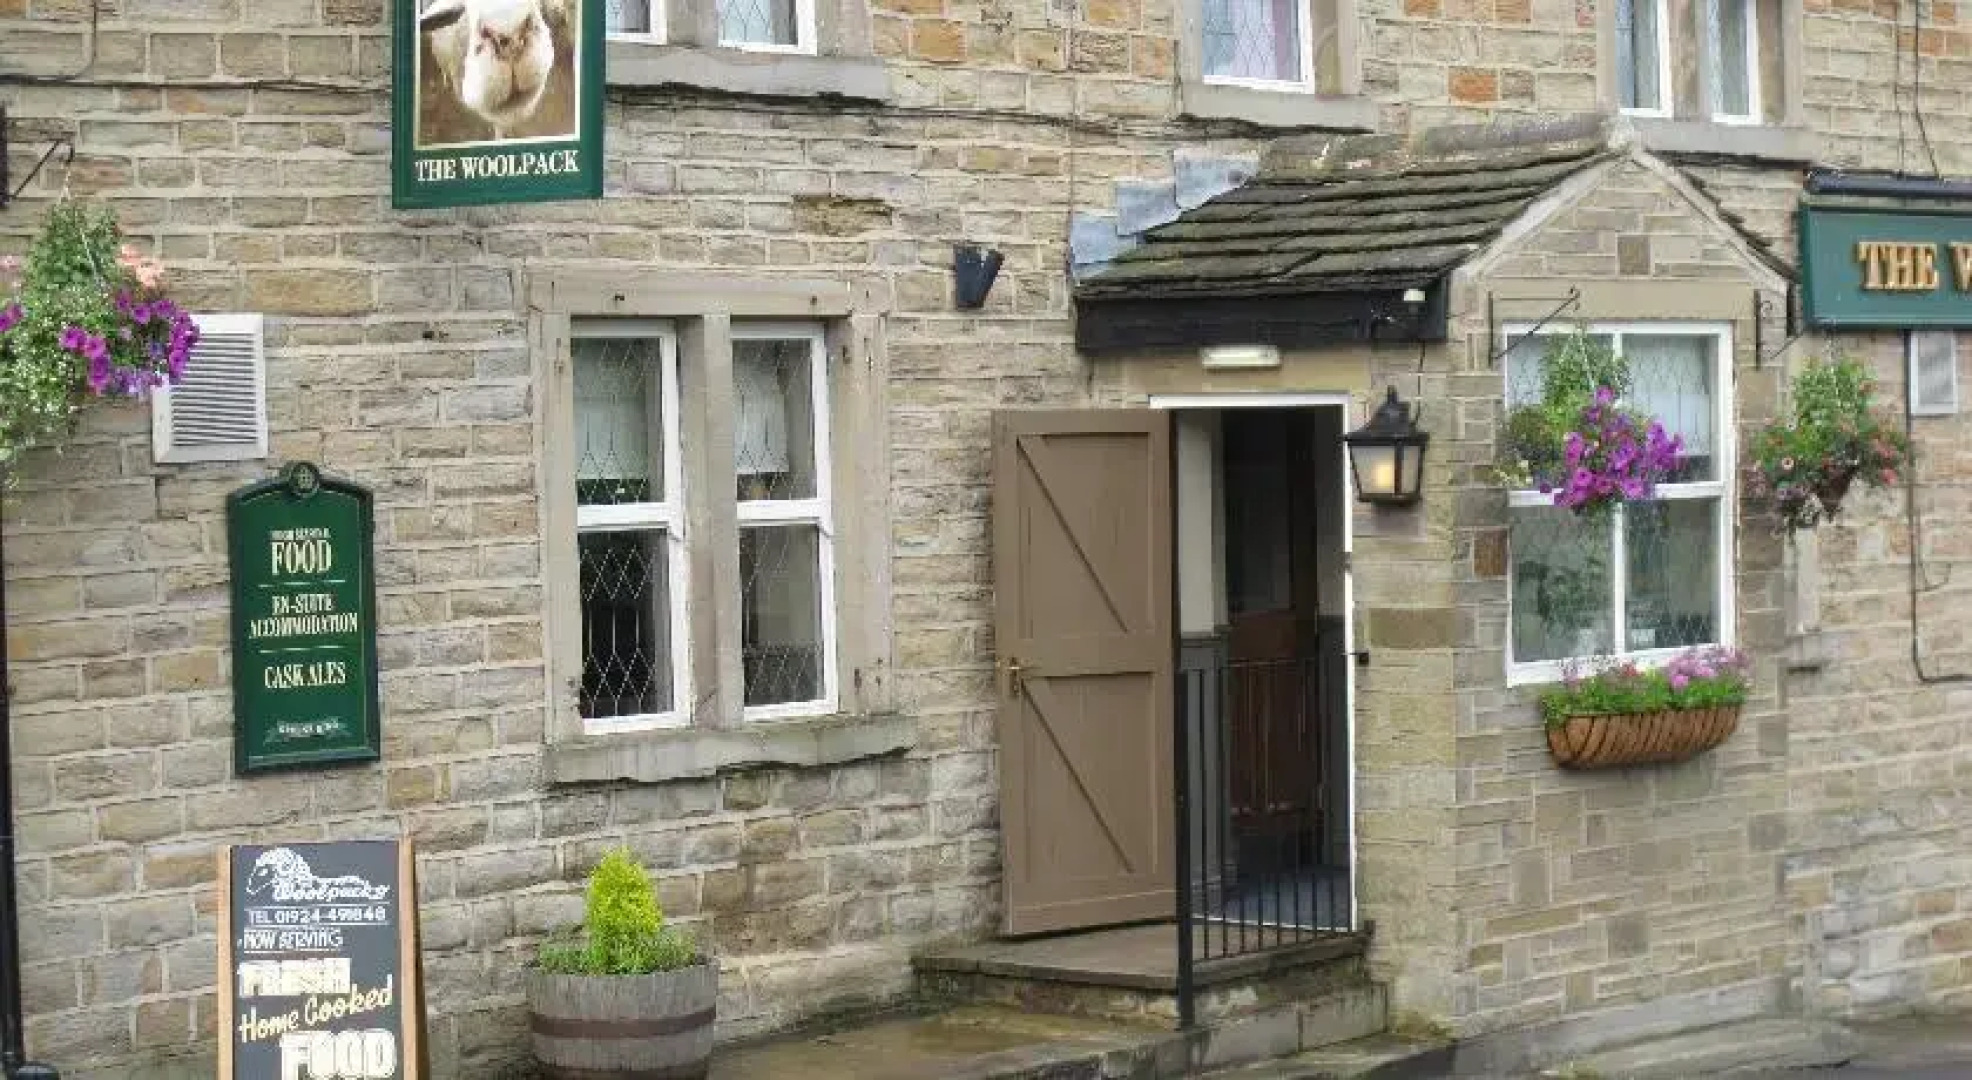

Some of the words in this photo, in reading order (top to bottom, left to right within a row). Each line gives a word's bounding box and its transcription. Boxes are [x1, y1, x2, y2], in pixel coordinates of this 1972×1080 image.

[415, 158, 457, 182] THE
[459, 149, 581, 179] WOOLPACK
[1856, 241, 1940, 291] THE
[271, 540, 332, 576] FOOD
[271, 593, 333, 616] EN-SUITE
[249, 612, 358, 639] ACCOMMODATION
[264, 664, 305, 689] CASK
[307, 661, 346, 687] ALES
[249, 910, 272, 924] TEL
[243, 929, 278, 949] NOW
[278, 927, 344, 949] SERVING
[239, 1006, 300, 1043] Home
[304, 973, 393, 1027] Cooked
[279, 1028, 398, 1080] FOOD
